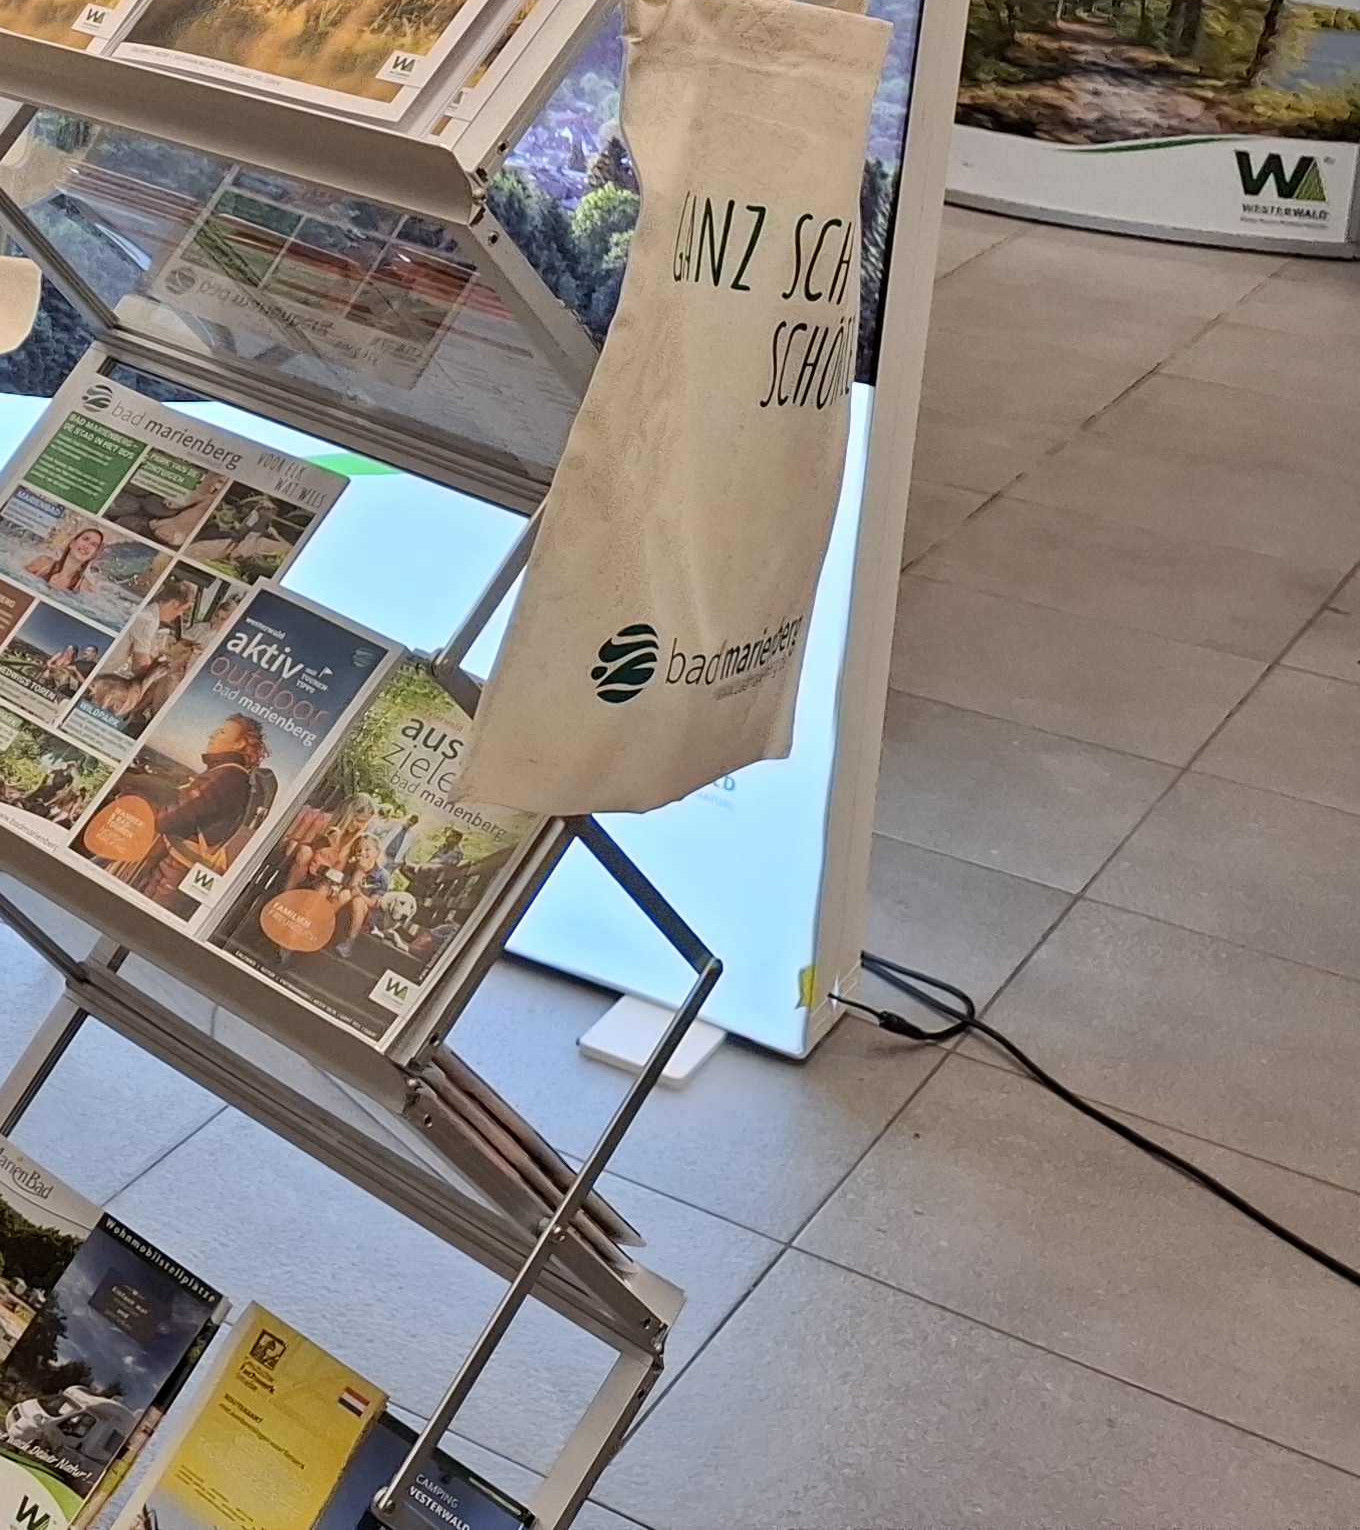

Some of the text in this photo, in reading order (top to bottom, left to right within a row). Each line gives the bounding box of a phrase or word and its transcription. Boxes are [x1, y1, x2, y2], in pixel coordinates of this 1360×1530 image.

[111, 400, 146, 427] bad
[145, 419, 243, 471] marienberg
[257, 450, 307, 481] VOOR ELK
[273, 476, 328, 509] WAT WILS
[226, 631, 305, 680] aktiv
[664, 636, 728, 686] bad
[29, 679, 57, 701] TOREN
[79, 700, 121, 728] WILDPARK
[210, 655, 330, 728] outdoor
[212, 679, 318, 747] bad marienberg
[389, 770, 508, 843] bad marienberg
[105, 1216, 217, 1304] Wohnmobilstellplätze
[415, 1473, 460, 1509] CAMPING
